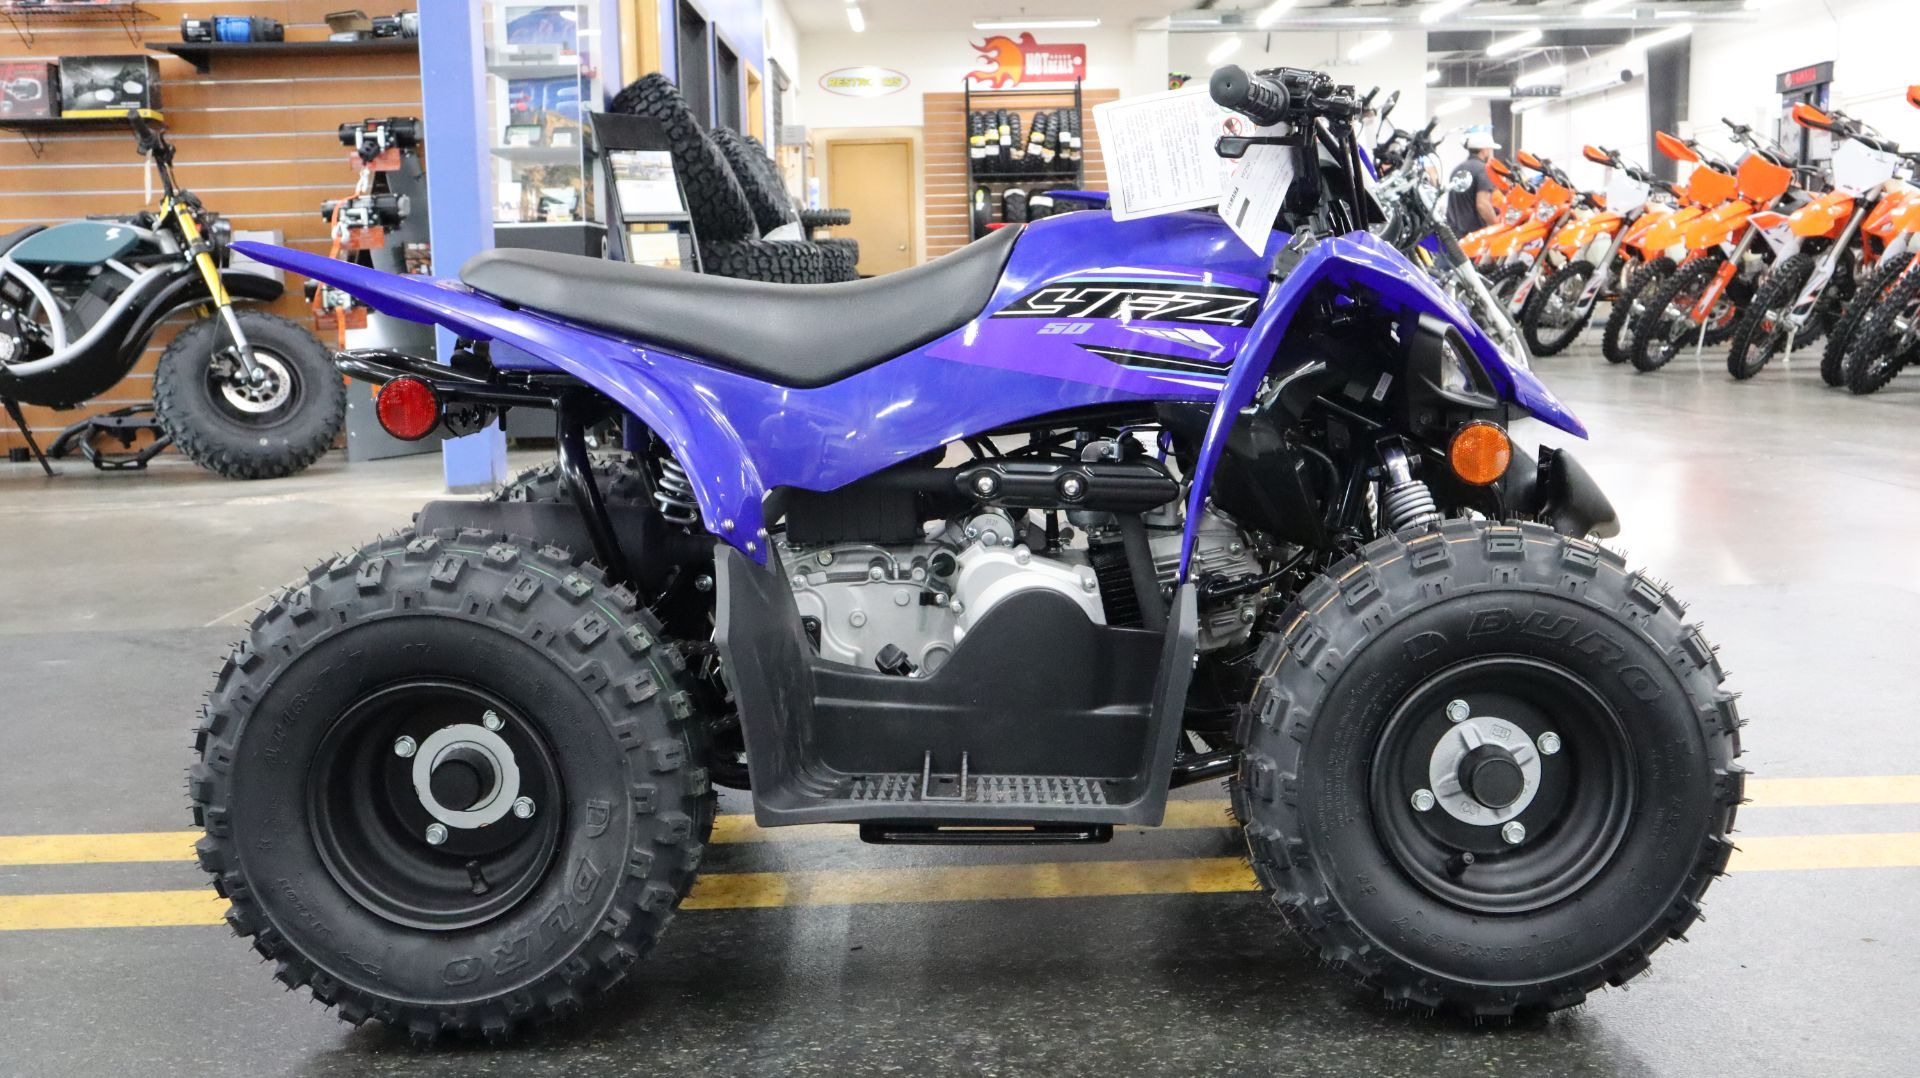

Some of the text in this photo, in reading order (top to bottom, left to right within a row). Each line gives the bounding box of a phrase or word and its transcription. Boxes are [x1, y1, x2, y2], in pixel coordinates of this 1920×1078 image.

[1025, 52, 1048, 75] HOT
[1037, 322, 1094, 335] 50
[1466, 607, 1663, 702] DURO
[444, 855, 601, 985] DURO
